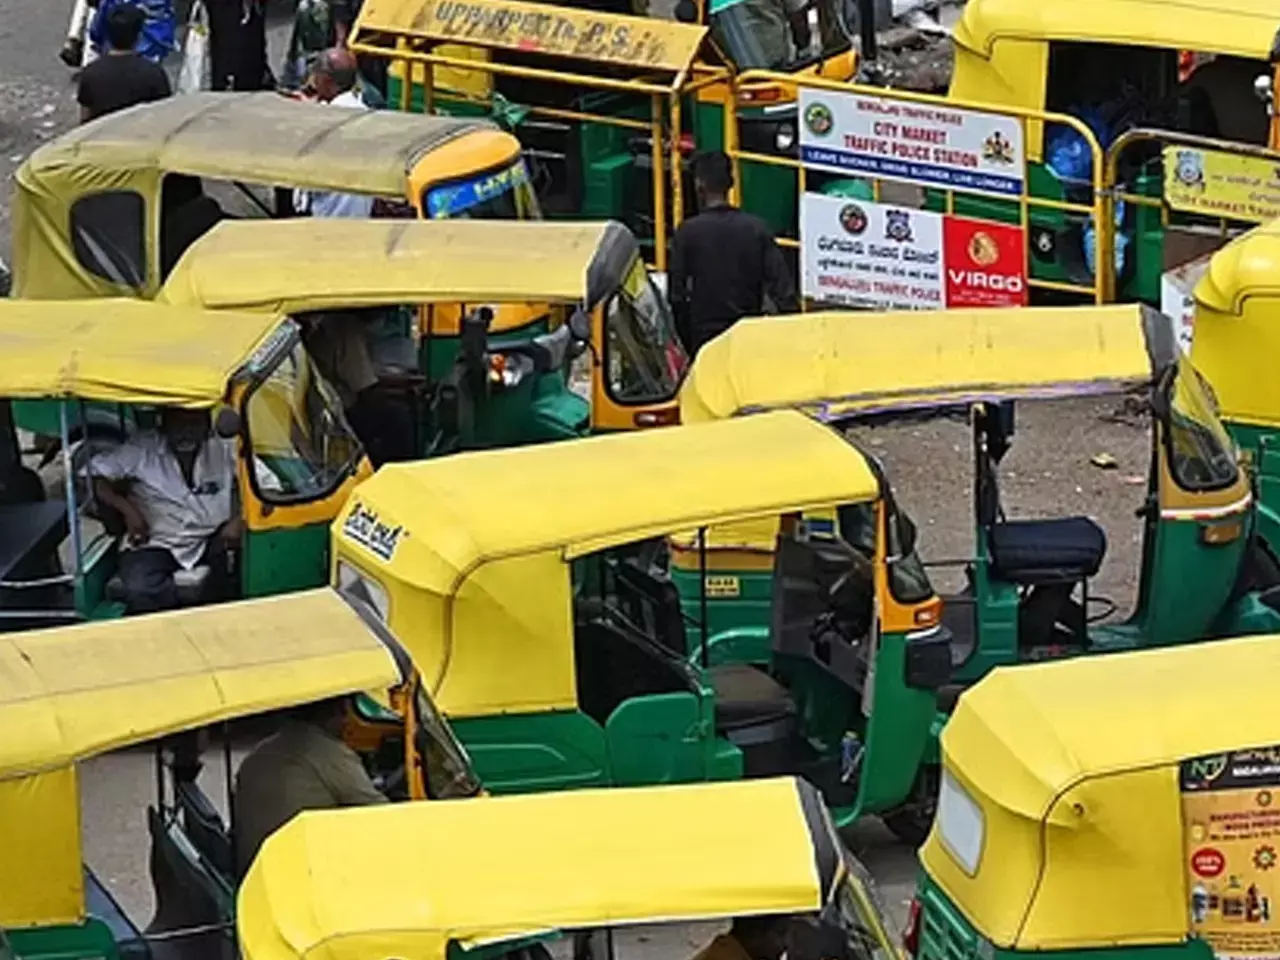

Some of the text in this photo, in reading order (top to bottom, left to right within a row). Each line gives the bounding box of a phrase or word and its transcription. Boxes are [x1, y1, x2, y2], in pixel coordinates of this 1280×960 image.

[873, 121, 947, 145] CITY MARKET
[843, 134, 978, 168] TRAFFIC POLICE STATION
[948, 268, 1023, 292] VIRGO
